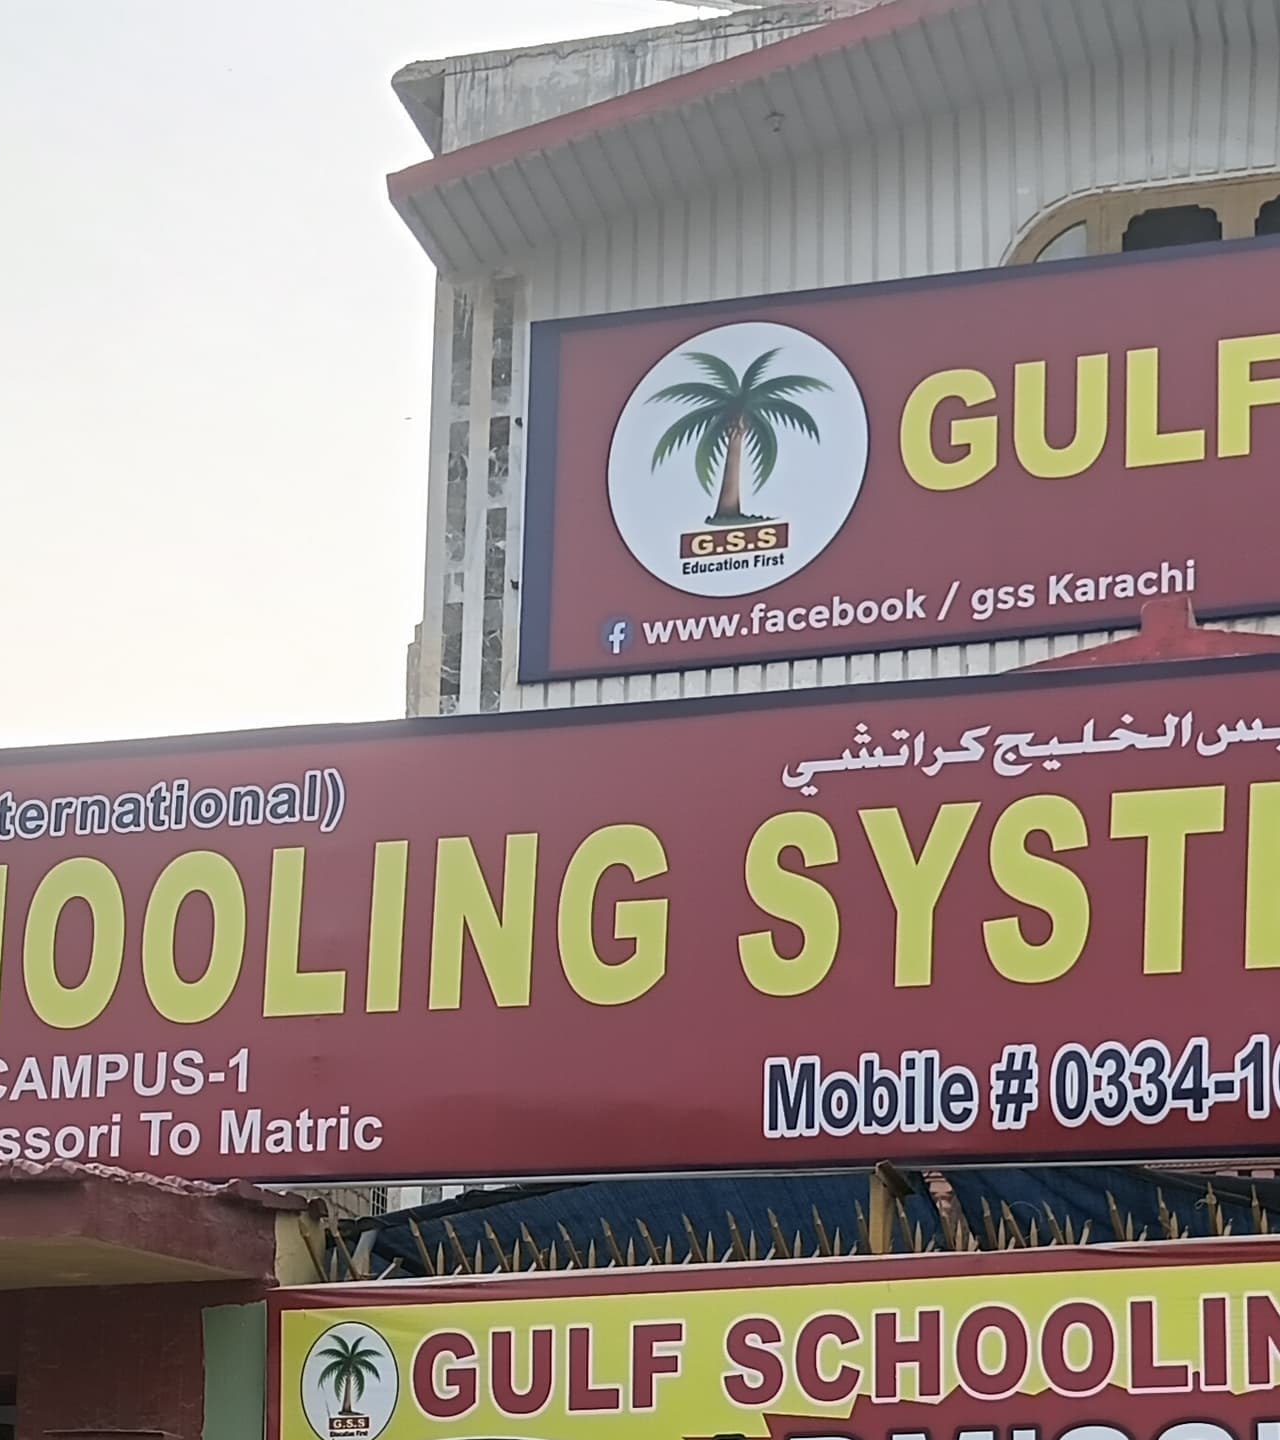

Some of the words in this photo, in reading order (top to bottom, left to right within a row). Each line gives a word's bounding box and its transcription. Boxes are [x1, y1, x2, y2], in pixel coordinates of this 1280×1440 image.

[682, 557, 750, 575] Education
[754, 552, 785, 568] First
[691, 527, 776, 555] G.S.S
[643, 589, 926, 646] www.facebook
[971, 583, 1035, 621] gss
[1048, 560, 1196, 604] Karachi
[782, 721, 991, 796] كراتشي
[991, 712, 1193, 777] الخليج
[763, 1050, 979, 1138] Mobile
[991, 1044, 1037, 1129] #
[140, 1109, 200, 1159] To
[219, 1105, 382, 1155] Matric
[410, 1319, 686, 1418] GULF
